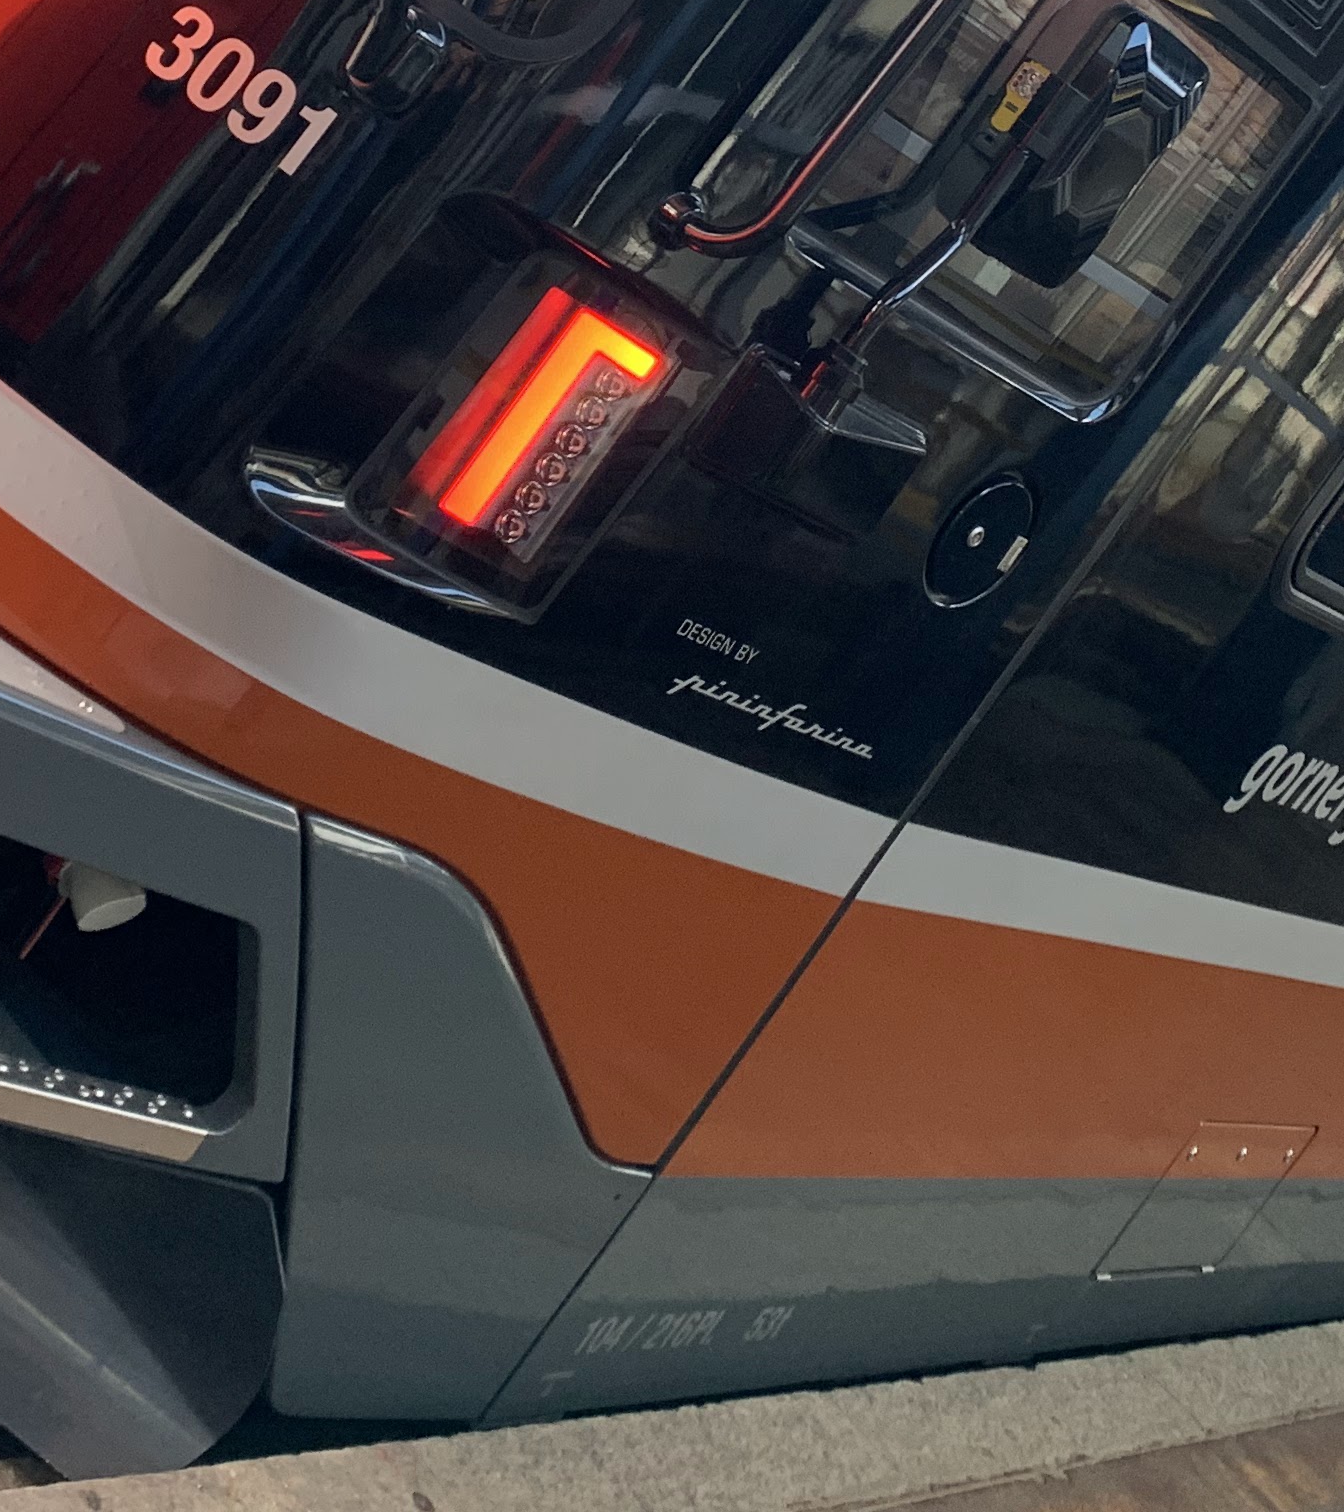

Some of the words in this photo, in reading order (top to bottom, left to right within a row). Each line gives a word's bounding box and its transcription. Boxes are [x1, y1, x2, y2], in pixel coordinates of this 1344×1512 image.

[145, 5, 338, 176] 3091
[676, 618, 737, 656] DESIGN
[734, 644, 760, 664] BY
[666, 675, 873, 759] pininfarina
